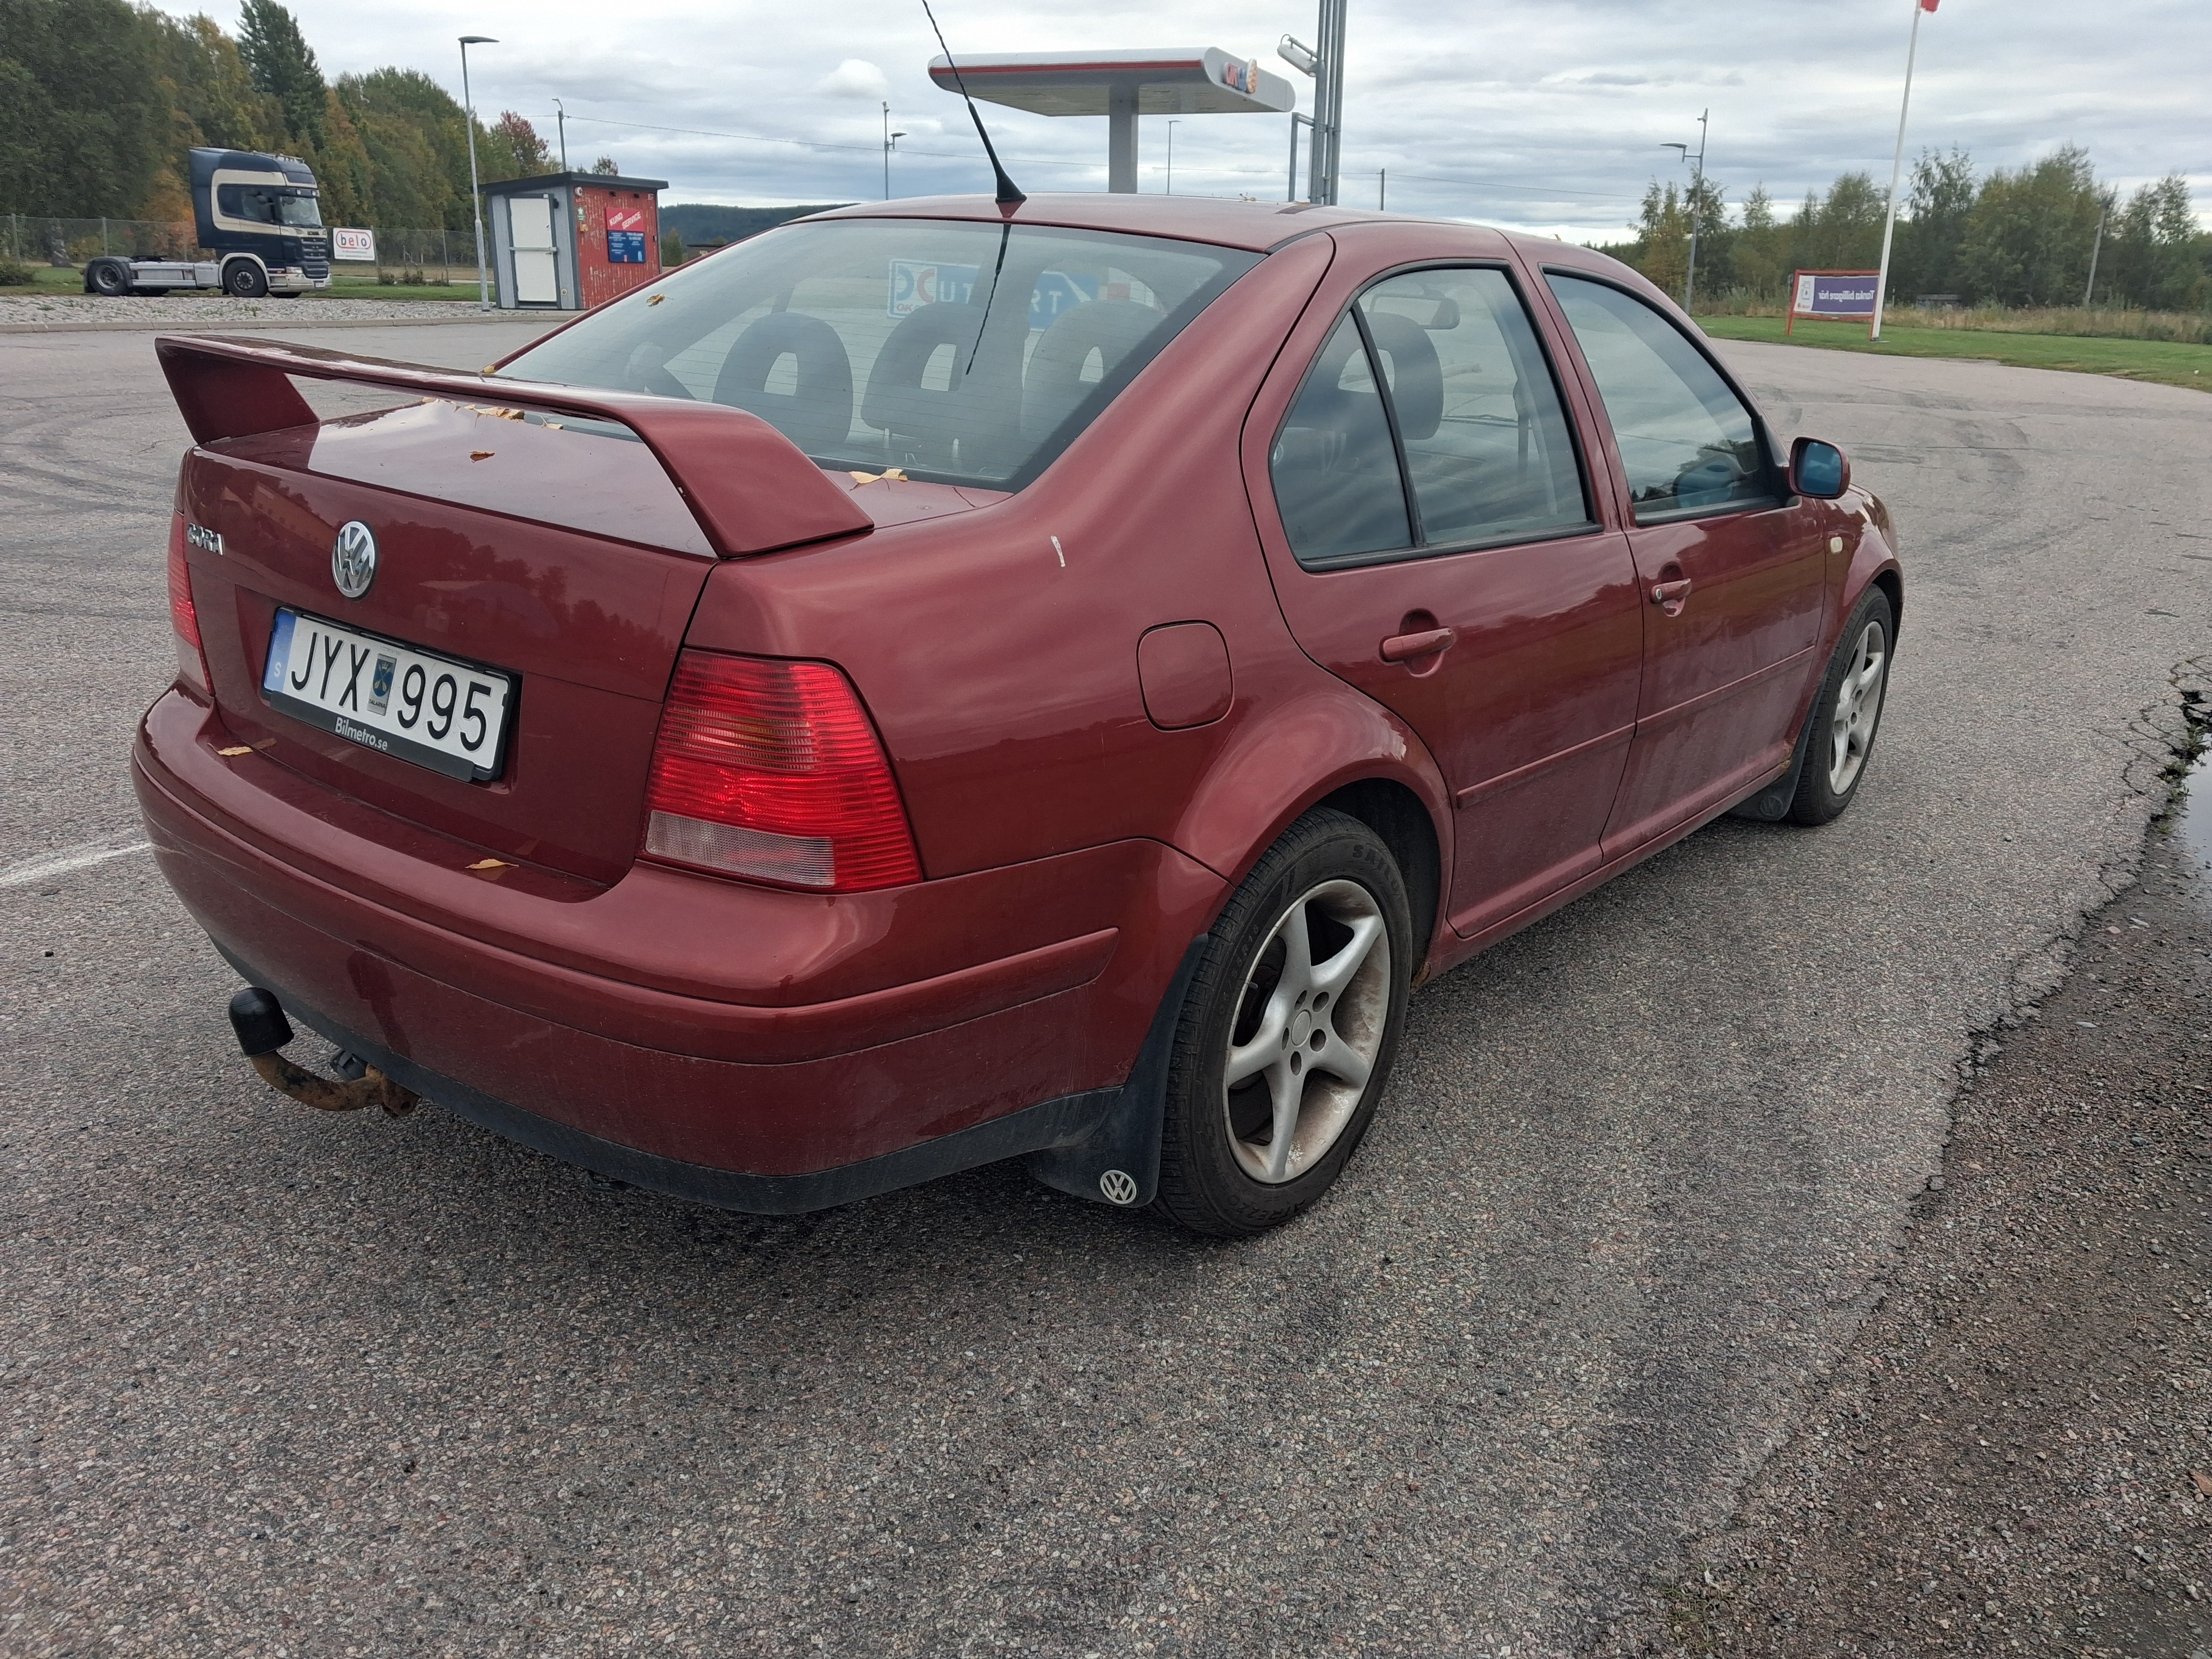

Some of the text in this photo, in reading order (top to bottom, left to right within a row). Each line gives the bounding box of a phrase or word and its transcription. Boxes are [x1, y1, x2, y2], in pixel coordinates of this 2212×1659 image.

[609, 212, 623, 226] KUND
[622, 211, 641, 229] SERVICE
[340, 233, 367, 247] belo
[940, 280, 1062, 314] UTRT
[274, 661, 281, 678] S
[291, 632, 491, 751] JYX 995
[335, 717, 388, 750] Bilmetro.se
